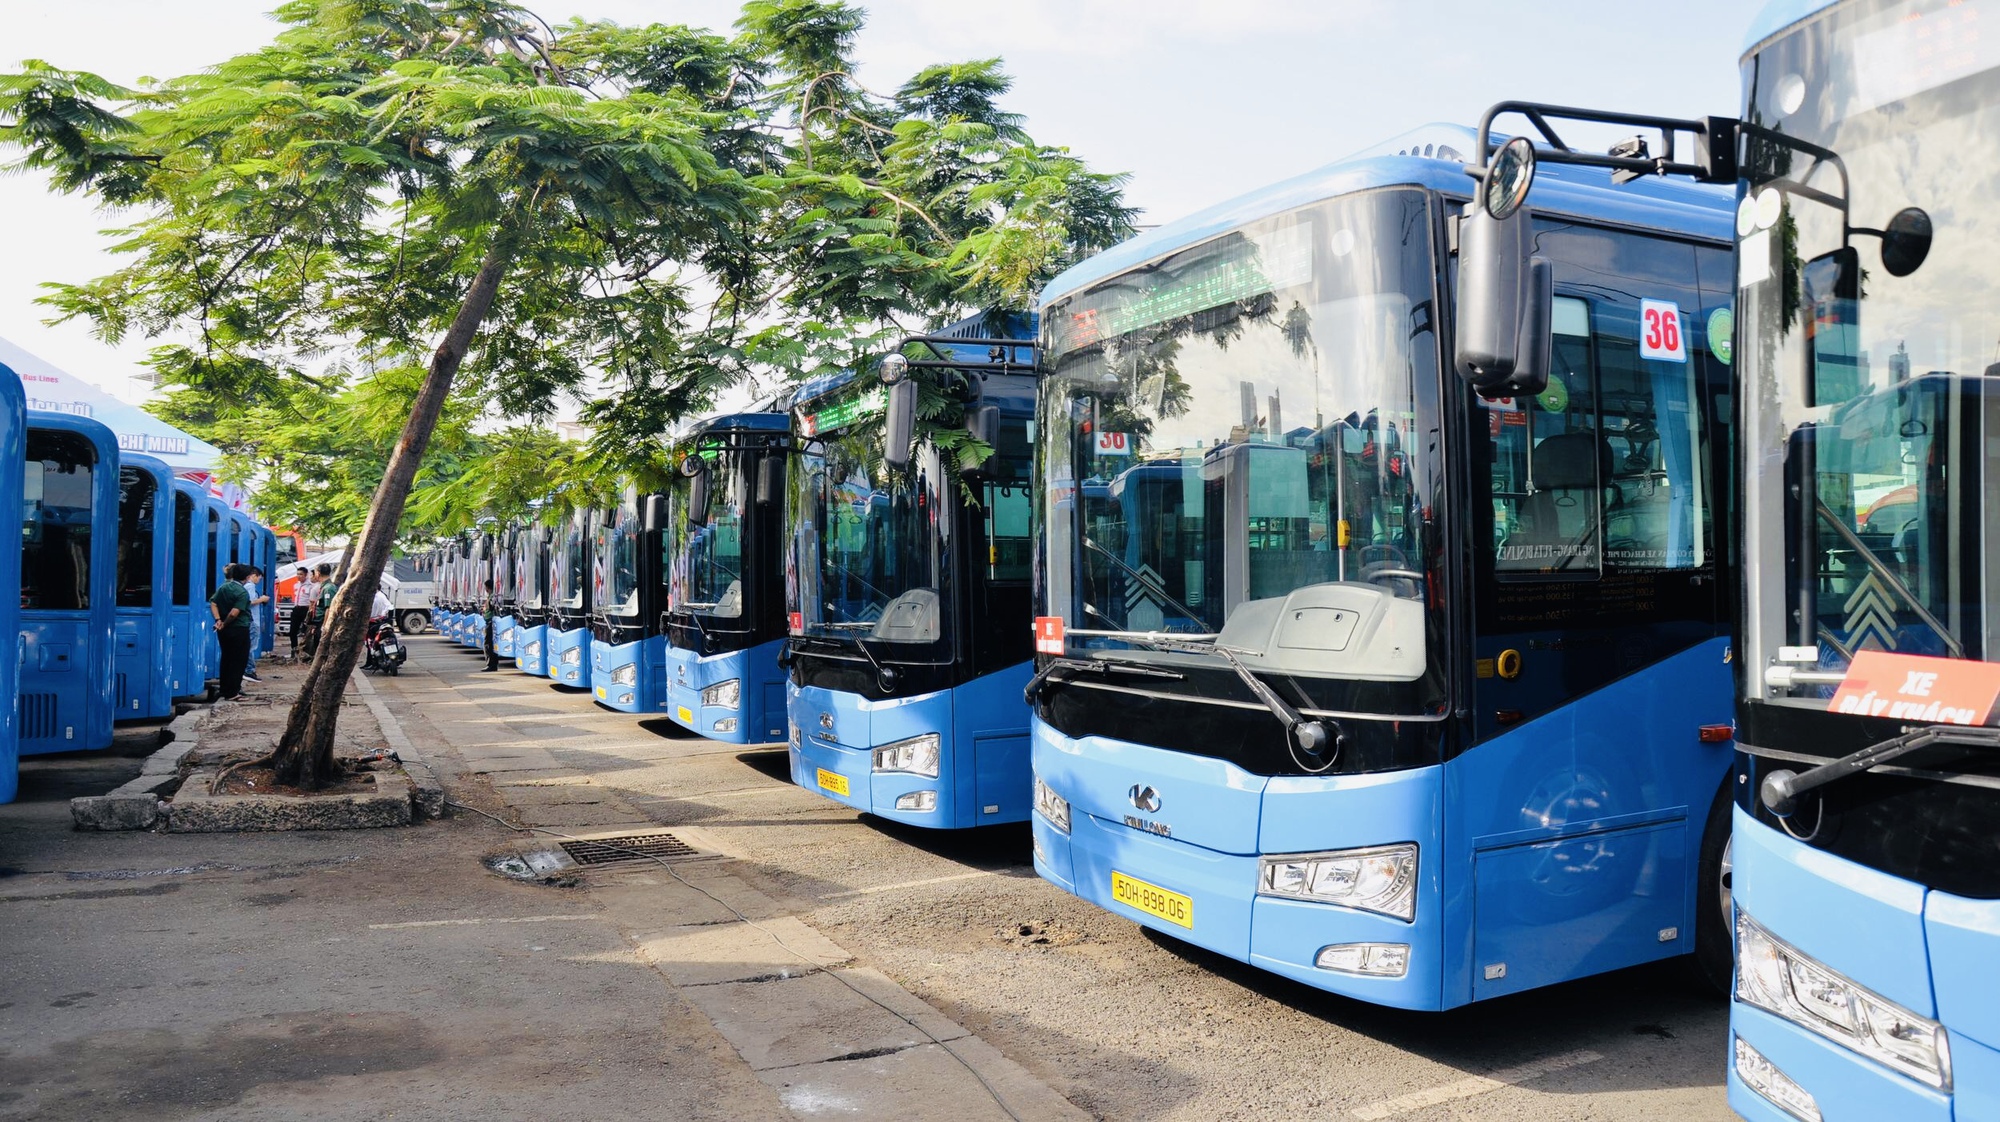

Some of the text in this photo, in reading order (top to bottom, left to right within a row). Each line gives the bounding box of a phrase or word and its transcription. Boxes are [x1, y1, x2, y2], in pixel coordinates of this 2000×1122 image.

[1645, 308, 1679, 351] 36
[23, 373, 60, 384] Bus Lines
[118, 433, 188, 455] CHÍ MINH
[1898, 671, 1938, 697] XE
[1118, 879, 1185, 920] 50H-898.06
